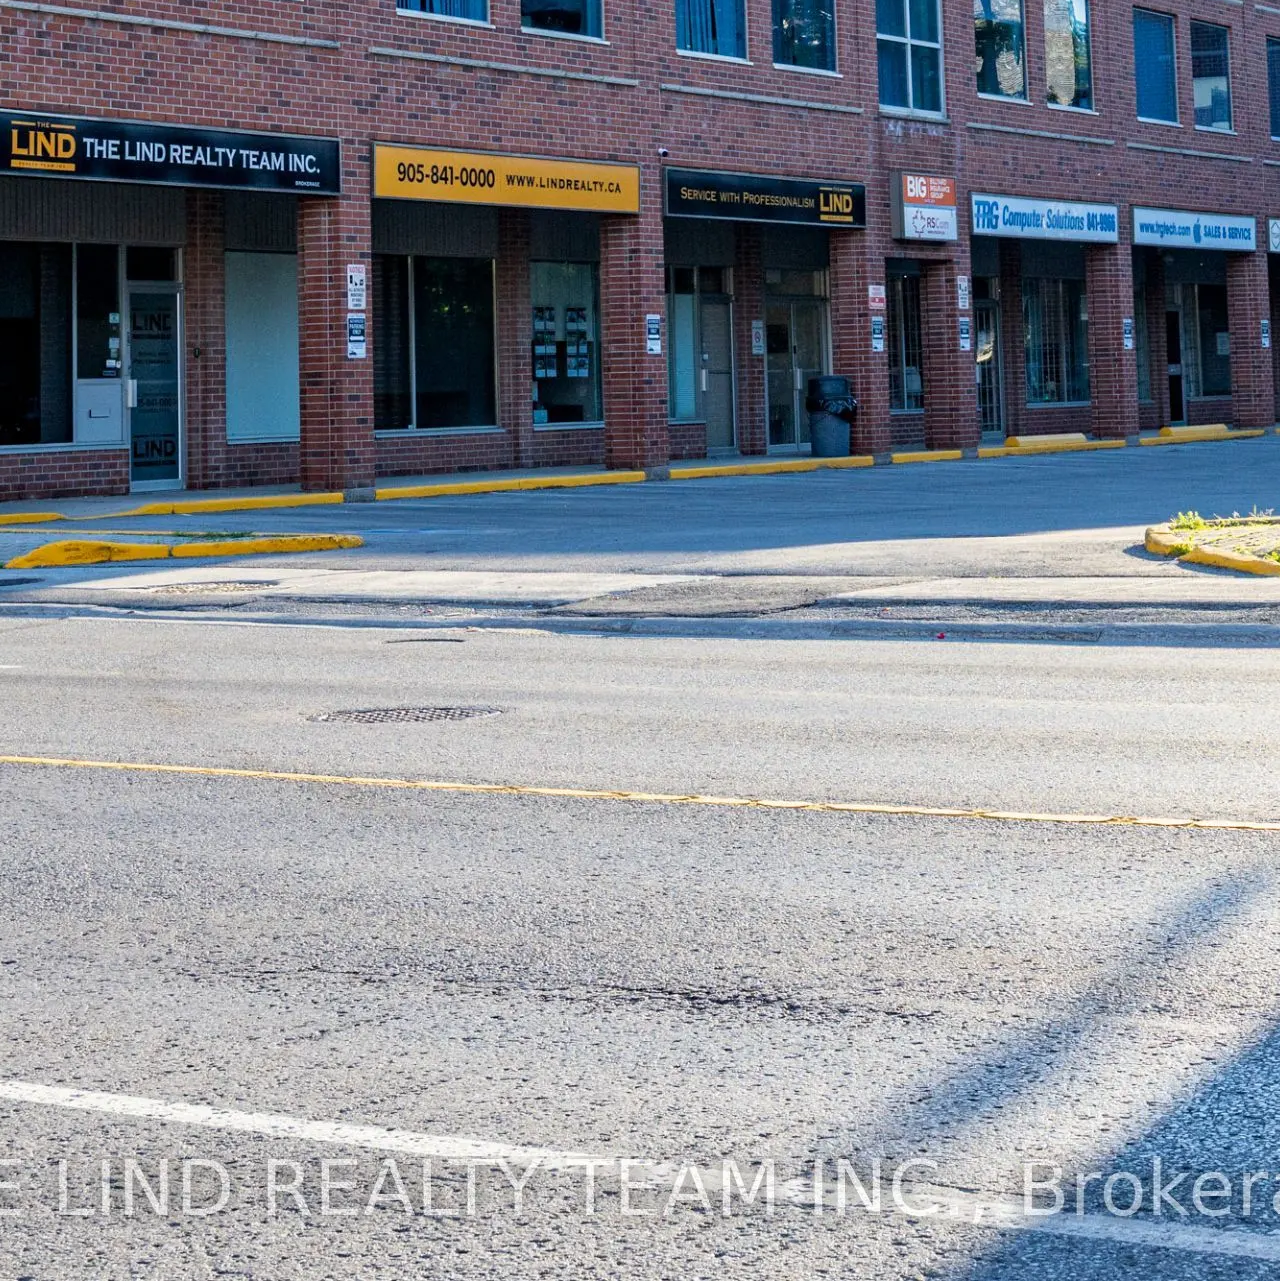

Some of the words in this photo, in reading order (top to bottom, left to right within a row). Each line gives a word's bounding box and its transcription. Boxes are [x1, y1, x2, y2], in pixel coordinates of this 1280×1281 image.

[11, 128, 77, 159] LIND
[82, 137, 121, 160] THE
[124, 140, 166, 163] LIND
[170, 144, 237, 168] REALTY
[239, 149, 285, 171] TEAM
[288, 153, 320, 174] INC.
[397, 162, 496, 188] 905-841-0000
[506, 173, 622, 194] WWW.LINDREALTY.CA
[907, 175, 927, 198] BIG
[680, 187, 717, 202] SERVICE
[720, 192, 740, 203] WITH
[743, 192, 815, 209] PROFESSIONALISM
[819, 193, 853, 213] LIND
[974, 200, 999, 230] TRG
[1002, 205, 1046, 232] Computer
[1046, 208, 1085, 231] Solutions
[1203, 225, 1221, 239] SALES
[1222, 228, 1227, 239] &
[1228, 227, 1252, 240] SERVICE
